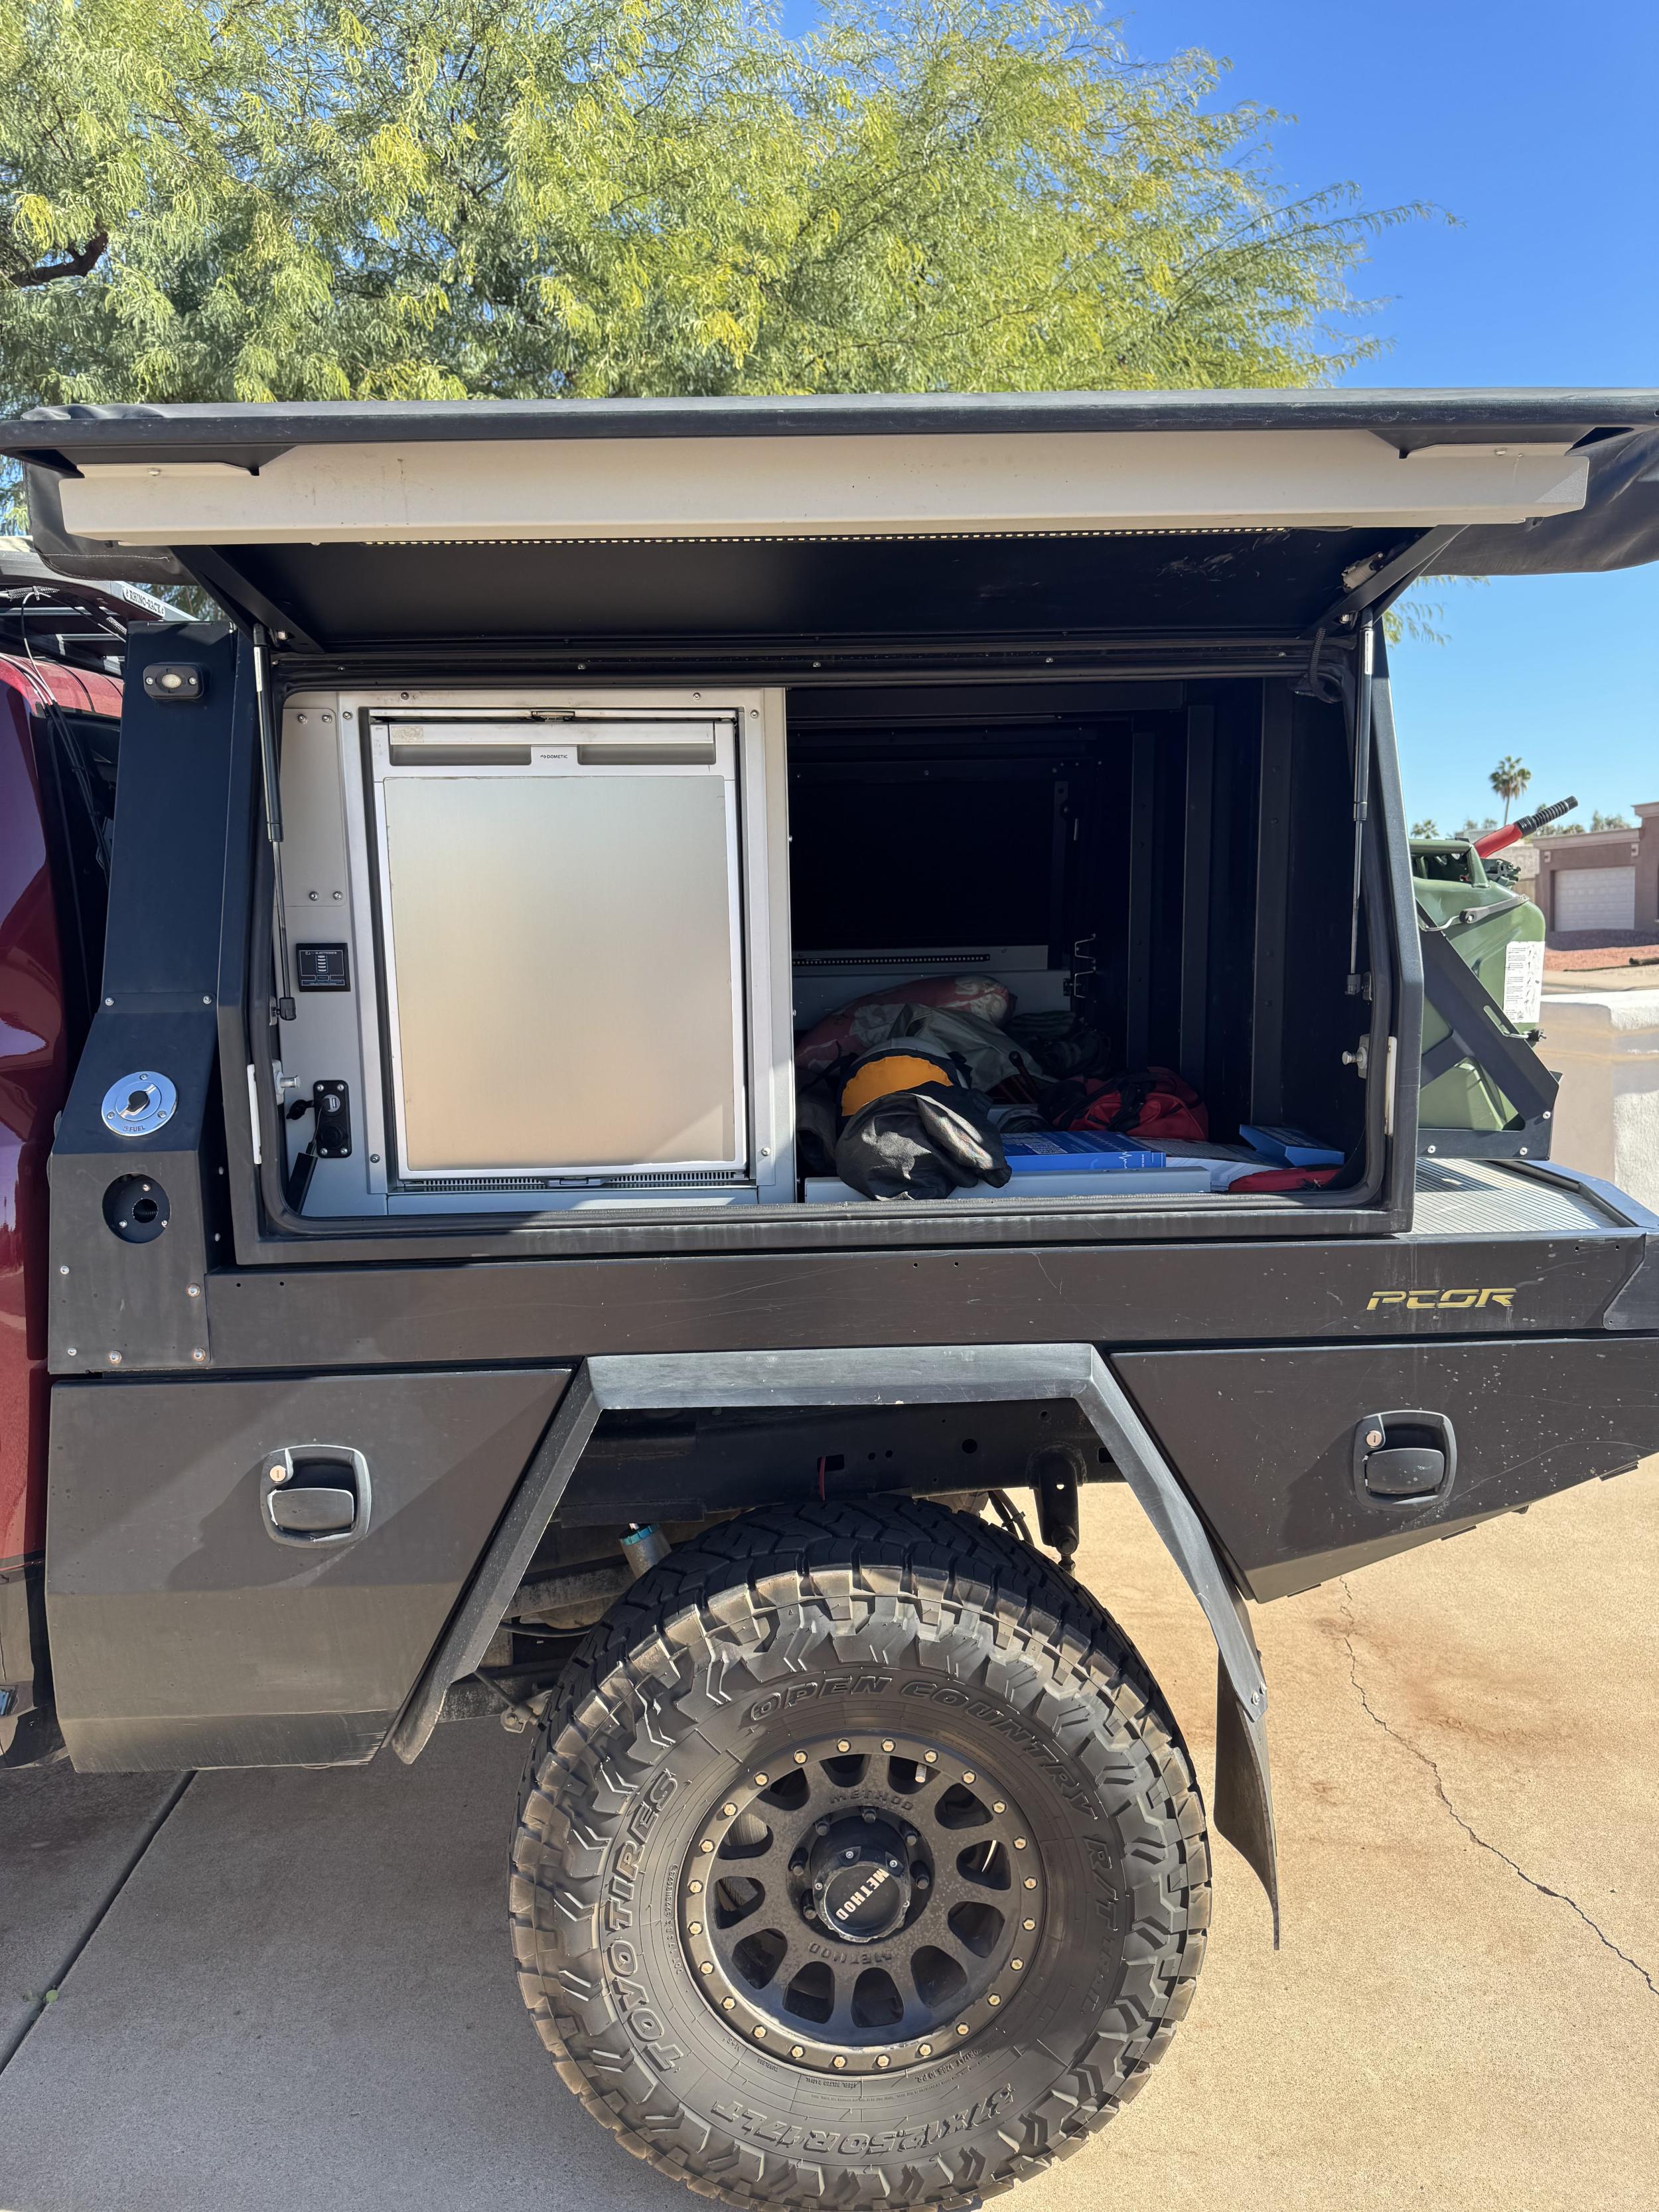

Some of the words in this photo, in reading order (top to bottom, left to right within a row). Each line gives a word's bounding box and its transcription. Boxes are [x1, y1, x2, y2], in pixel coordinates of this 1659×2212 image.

[129, 589, 161, 615] RHINO-RACK
[750, 1675, 893, 1722] OPEN
[900, 1680, 1099, 1820] COUNTRY
[830, 1789, 914, 1811] METHOD
[604, 1767, 678, 1931] TIRES
[835, 1868, 890, 1921] METHOD
[808, 1942, 893, 1965] METHOD
[607, 1939, 685, 2072] TOYO
